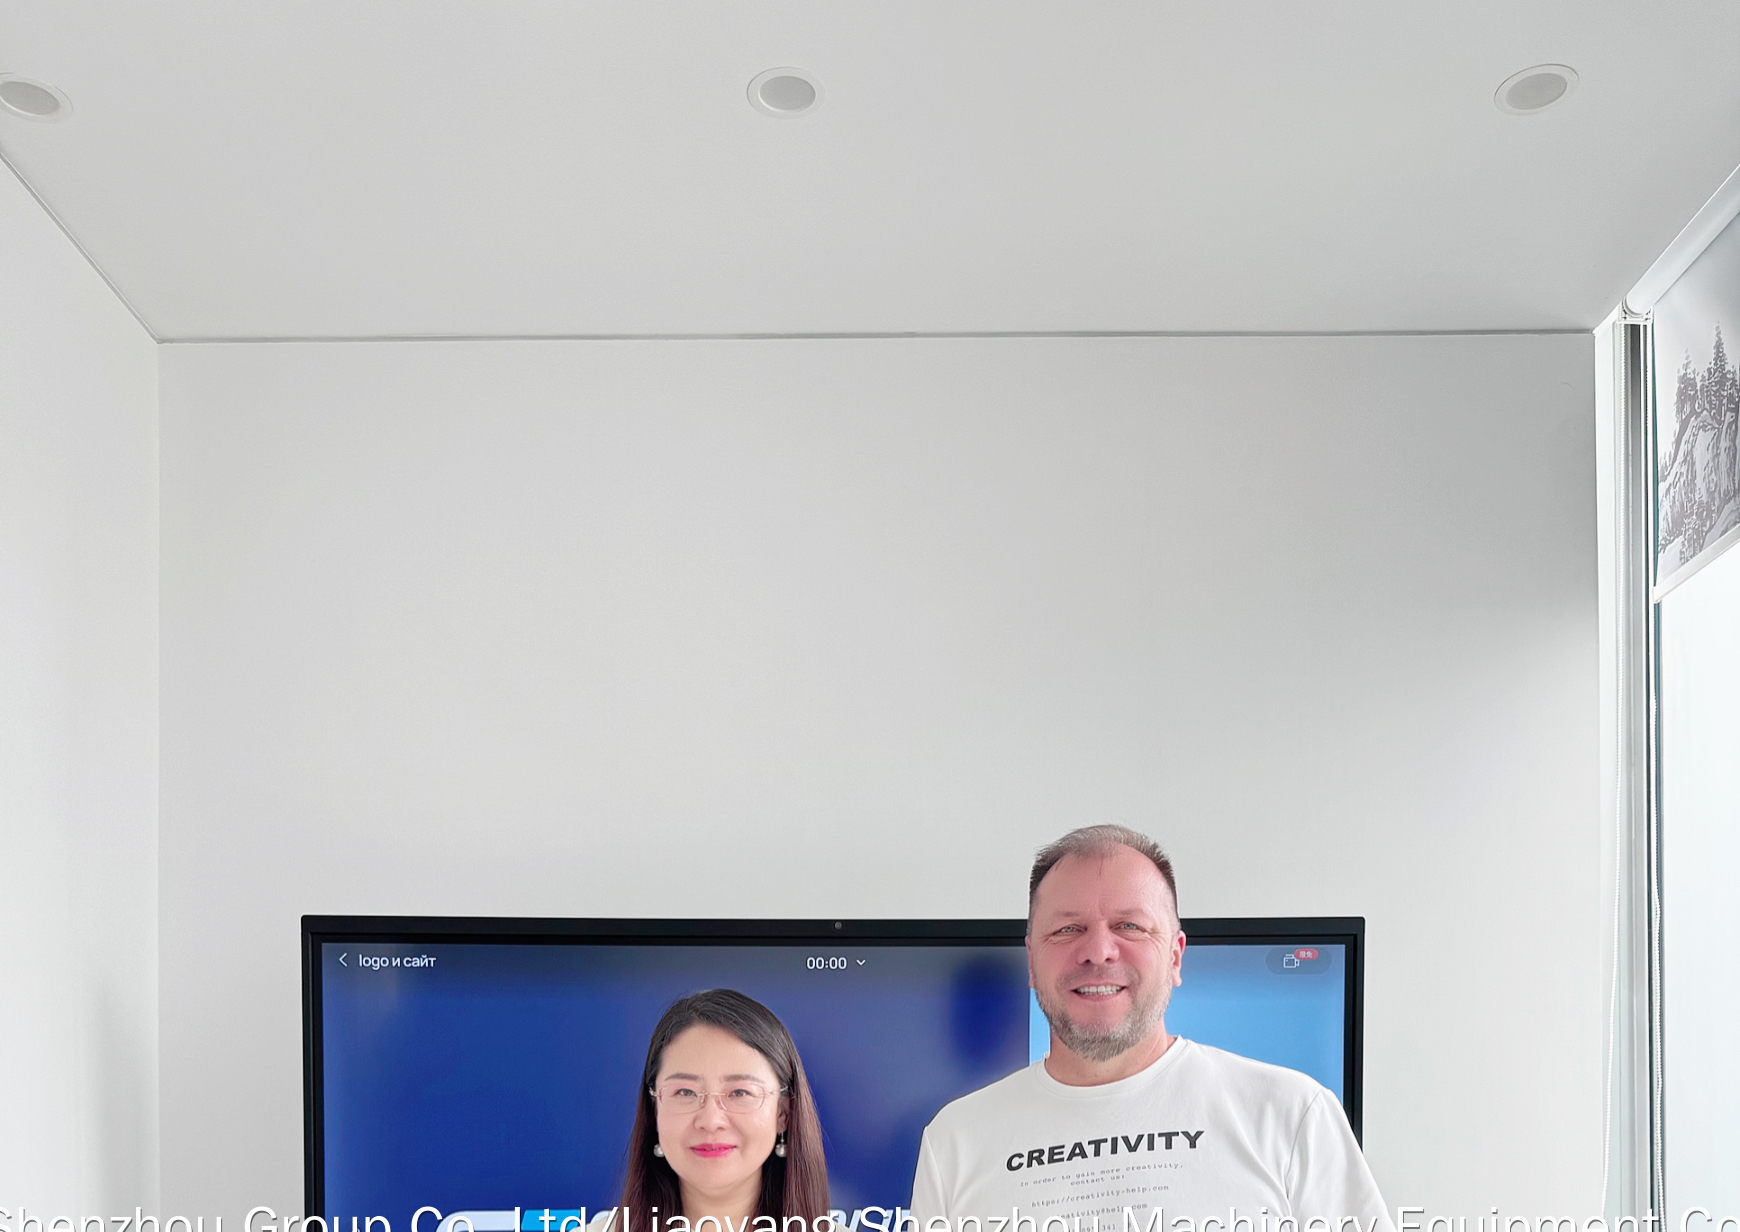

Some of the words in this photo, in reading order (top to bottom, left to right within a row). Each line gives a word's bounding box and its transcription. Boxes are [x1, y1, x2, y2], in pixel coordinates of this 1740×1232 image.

[359, 954, 389, 970] logo
[392, 957, 401, 967] и
[403, 954, 436, 967] сайт
[806, 956, 847, 970] 00:00
[1006, 1130, 1205, 1172] CREATIVITY
[1033, 1177, 1056, 1185] order
[1075, 1171, 1095, 1179] gain
[1126, 1163, 1183, 1172] creativity,
[1070, 1177, 1105, 1186] contact
[1032, 1185, 1169, 1208] https://creativity-help.com
